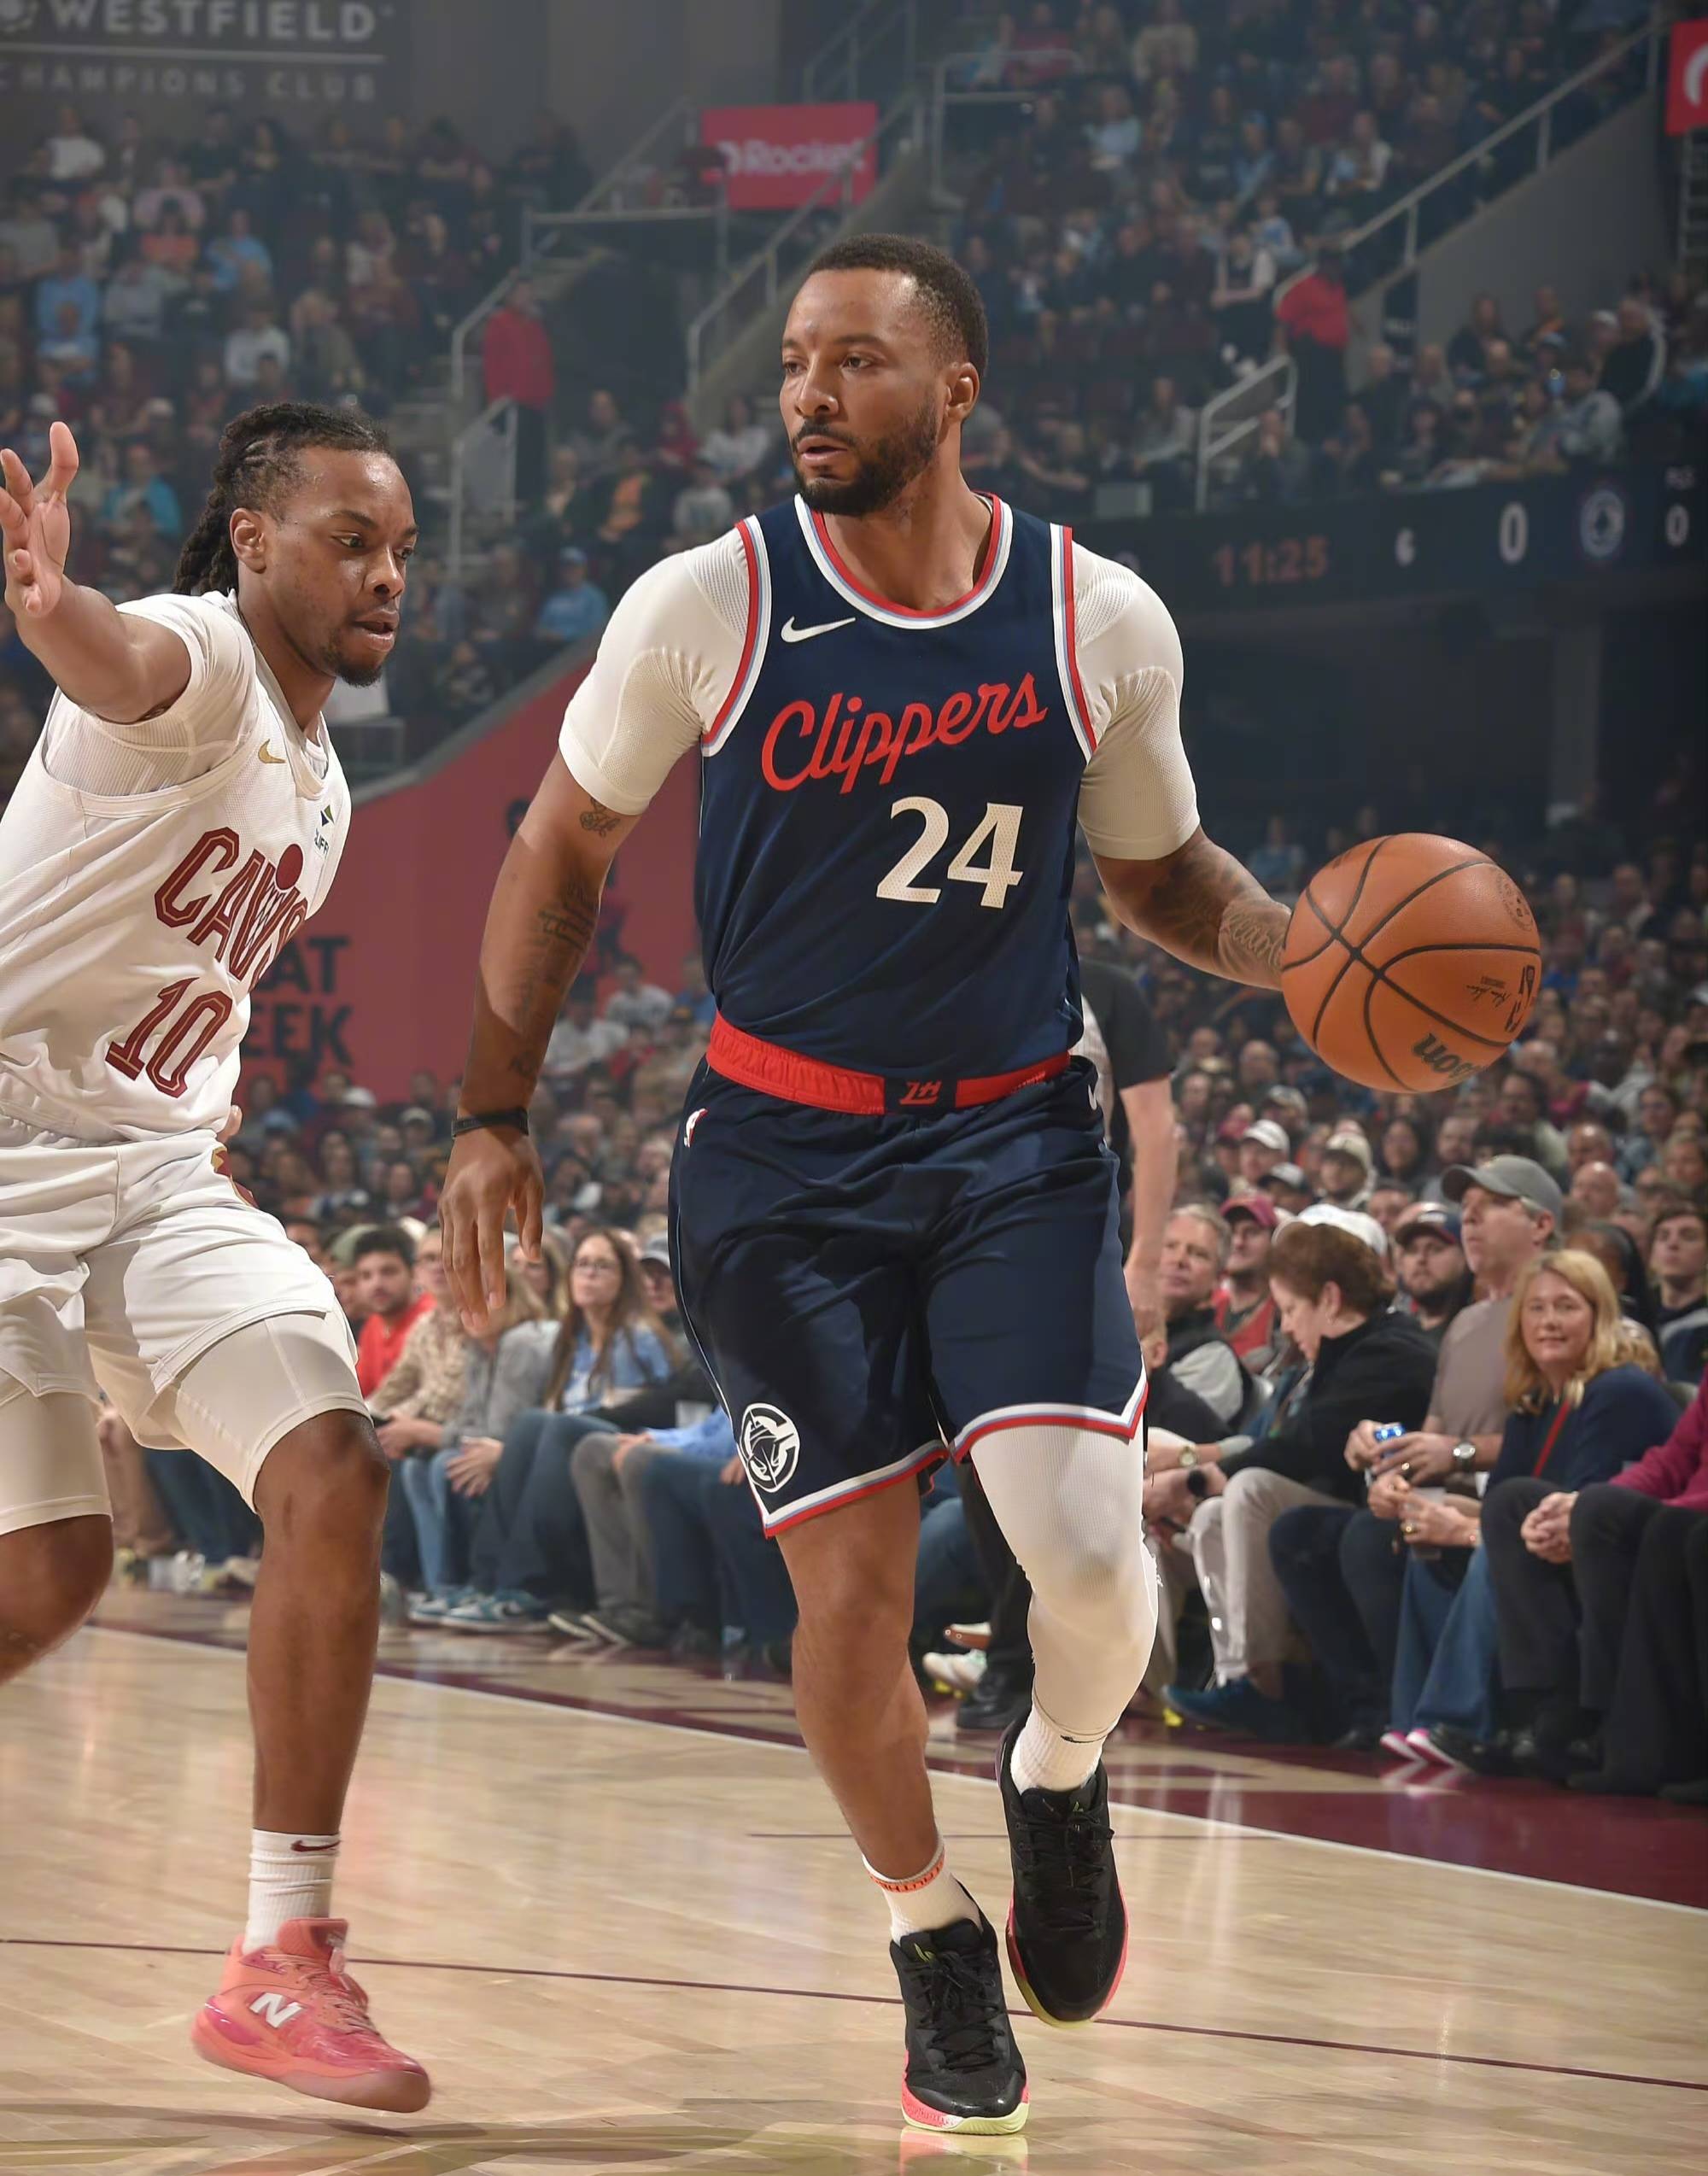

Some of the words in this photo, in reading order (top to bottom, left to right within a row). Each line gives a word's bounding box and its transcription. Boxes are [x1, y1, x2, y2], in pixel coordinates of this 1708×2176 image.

[50, 0, 377, 40] WESTFIELD
[266, 70, 377, 102] CLUB
[1214, 535, 1329, 587] 11:25
[1499, 500, 1528, 564] 0
[762, 672, 1049, 794] Clippers
[876, 796, 1024, 909] 24
[155, 827, 307, 993] CAVS
[256, 935, 348, 993] AT
[106, 977, 232, 1098] 10
[243, 1003, 353, 1065] EEK
[249, 1992, 303, 2028] N
